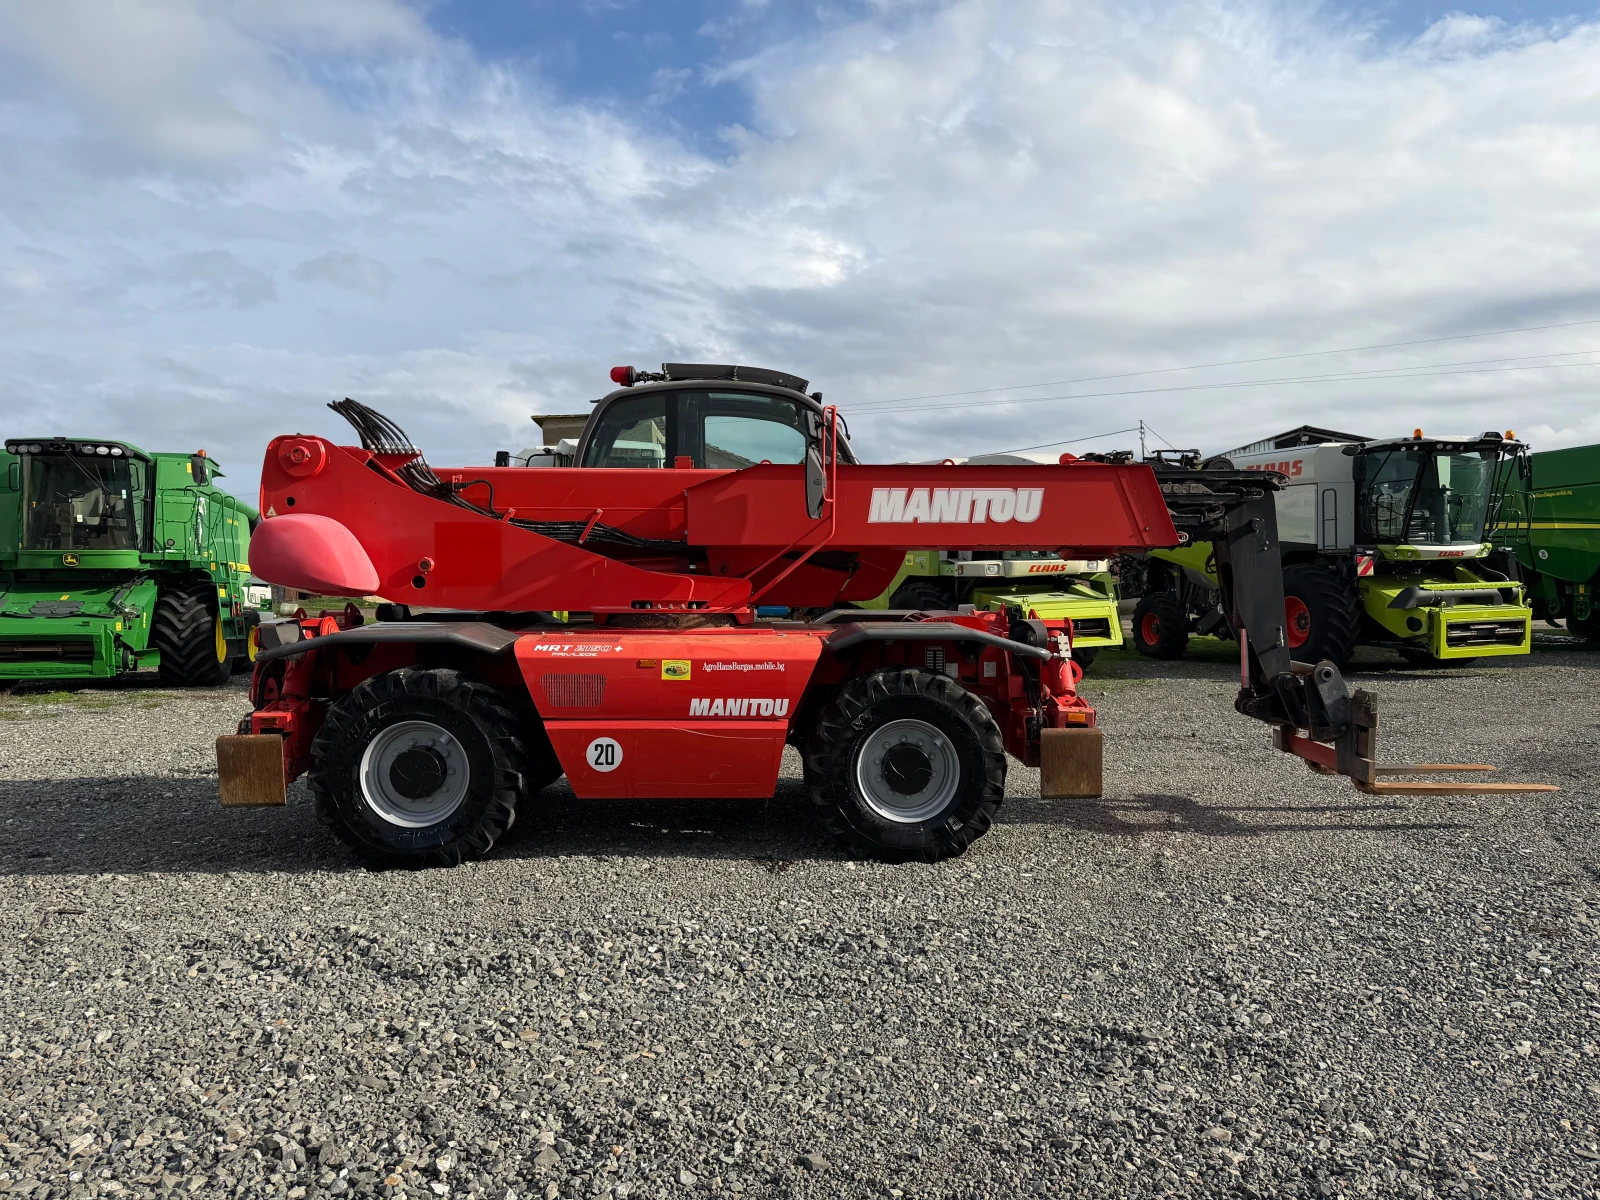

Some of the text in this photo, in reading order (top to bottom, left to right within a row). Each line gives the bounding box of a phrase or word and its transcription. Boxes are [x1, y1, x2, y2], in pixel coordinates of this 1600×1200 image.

[868, 487, 1044, 523] MANITOU
[1029, 564, 1067, 573] CLAAS
[533, 644, 573, 652] MRT
[702, 661, 785, 672] AgroHausBurgas.mobile.bg
[689, 698, 789, 717] MANITOU
[594, 743, 615, 766] 20
